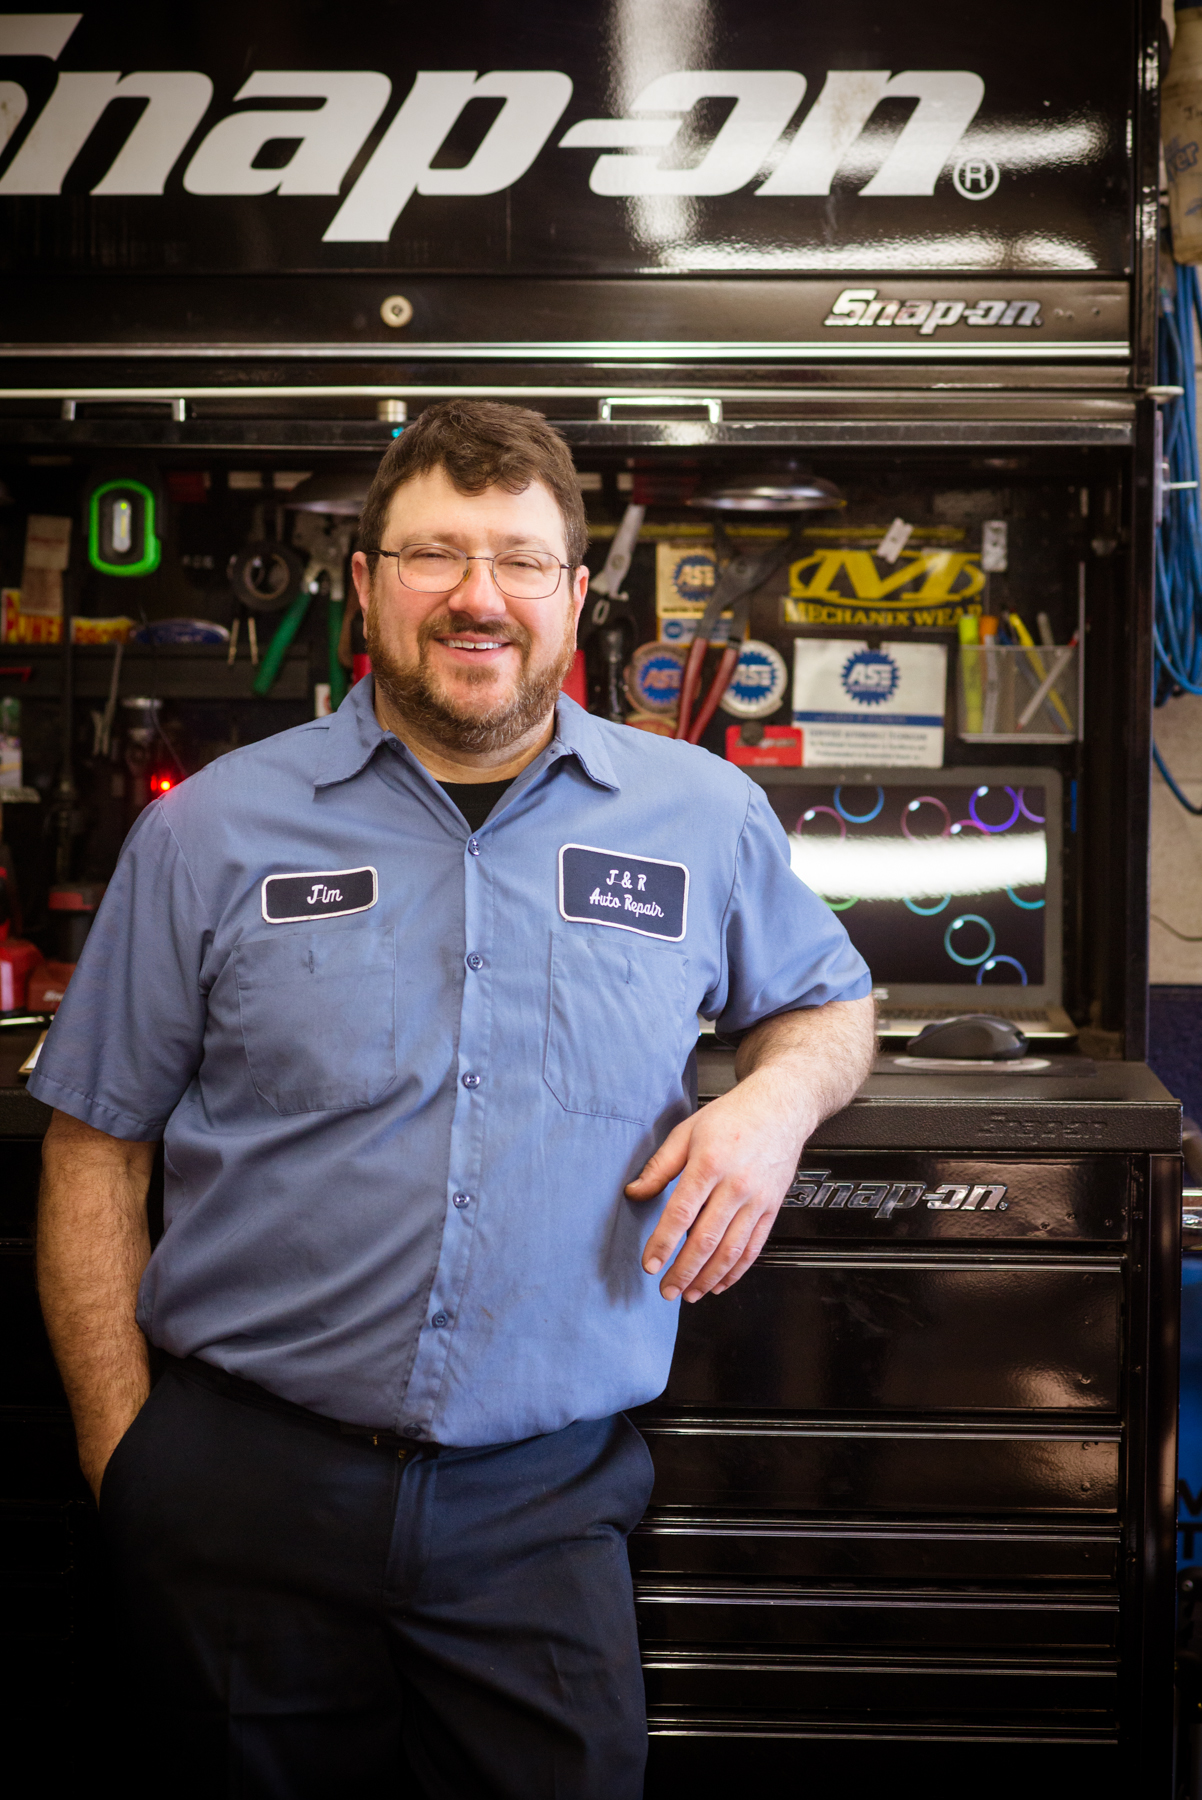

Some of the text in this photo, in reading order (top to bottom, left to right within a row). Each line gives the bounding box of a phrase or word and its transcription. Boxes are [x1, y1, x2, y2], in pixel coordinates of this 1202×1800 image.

[824, 288, 1042, 335] Snap-on
[785, 599, 909, 626] MECHANIX
[847, 663, 893, 687] ASE
[606, 869, 647, 892] J & R
[306, 884, 344, 905] Jim
[589, 887, 665, 918] Auto Repair
